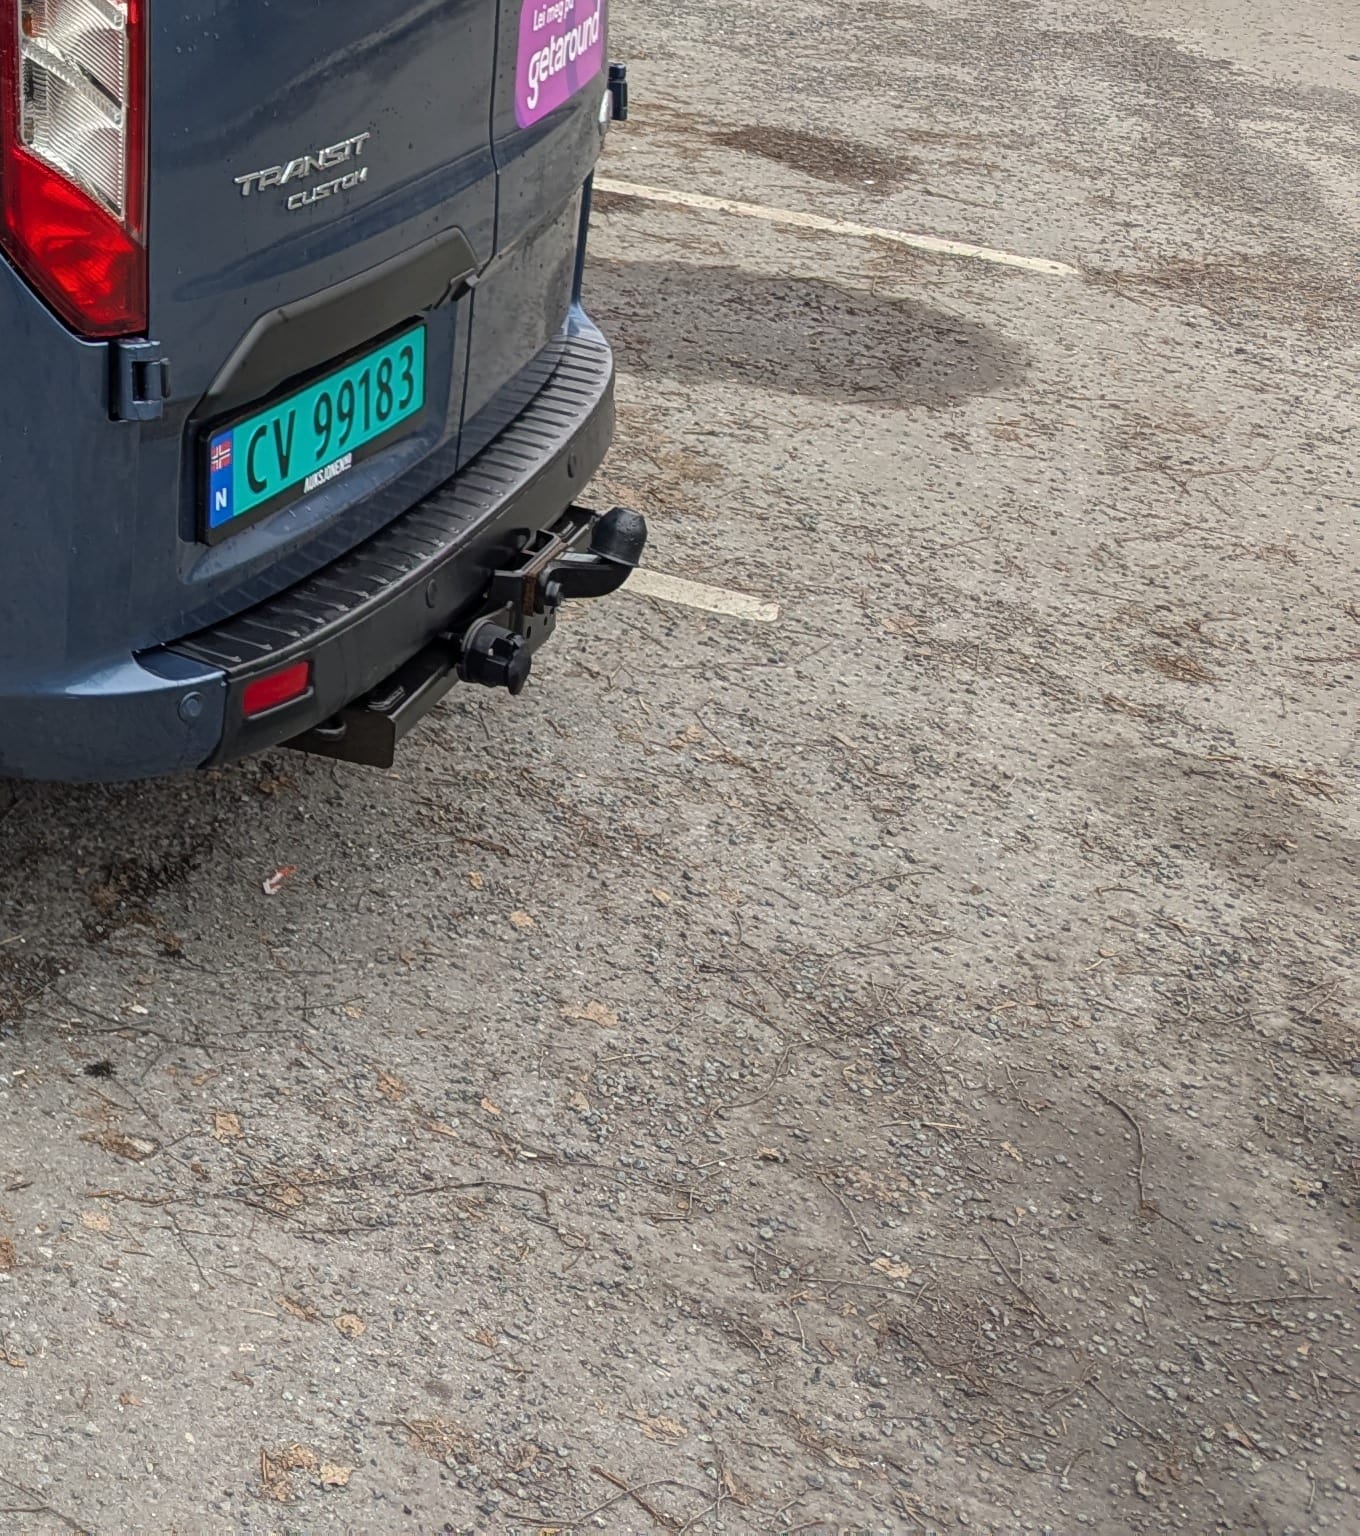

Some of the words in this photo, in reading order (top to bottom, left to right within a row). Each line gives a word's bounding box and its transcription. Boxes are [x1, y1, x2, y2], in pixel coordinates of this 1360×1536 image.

[532, 4, 546, 32] Lei
[546, 0, 564, 24] meg
[233, 131, 371, 196] TRANSIT
[287, 166, 369, 211] CUSTOM
[215, 487, 228, 512] N
[246, 408, 296, 494] CV
[312, 344, 415, 462] 99183
